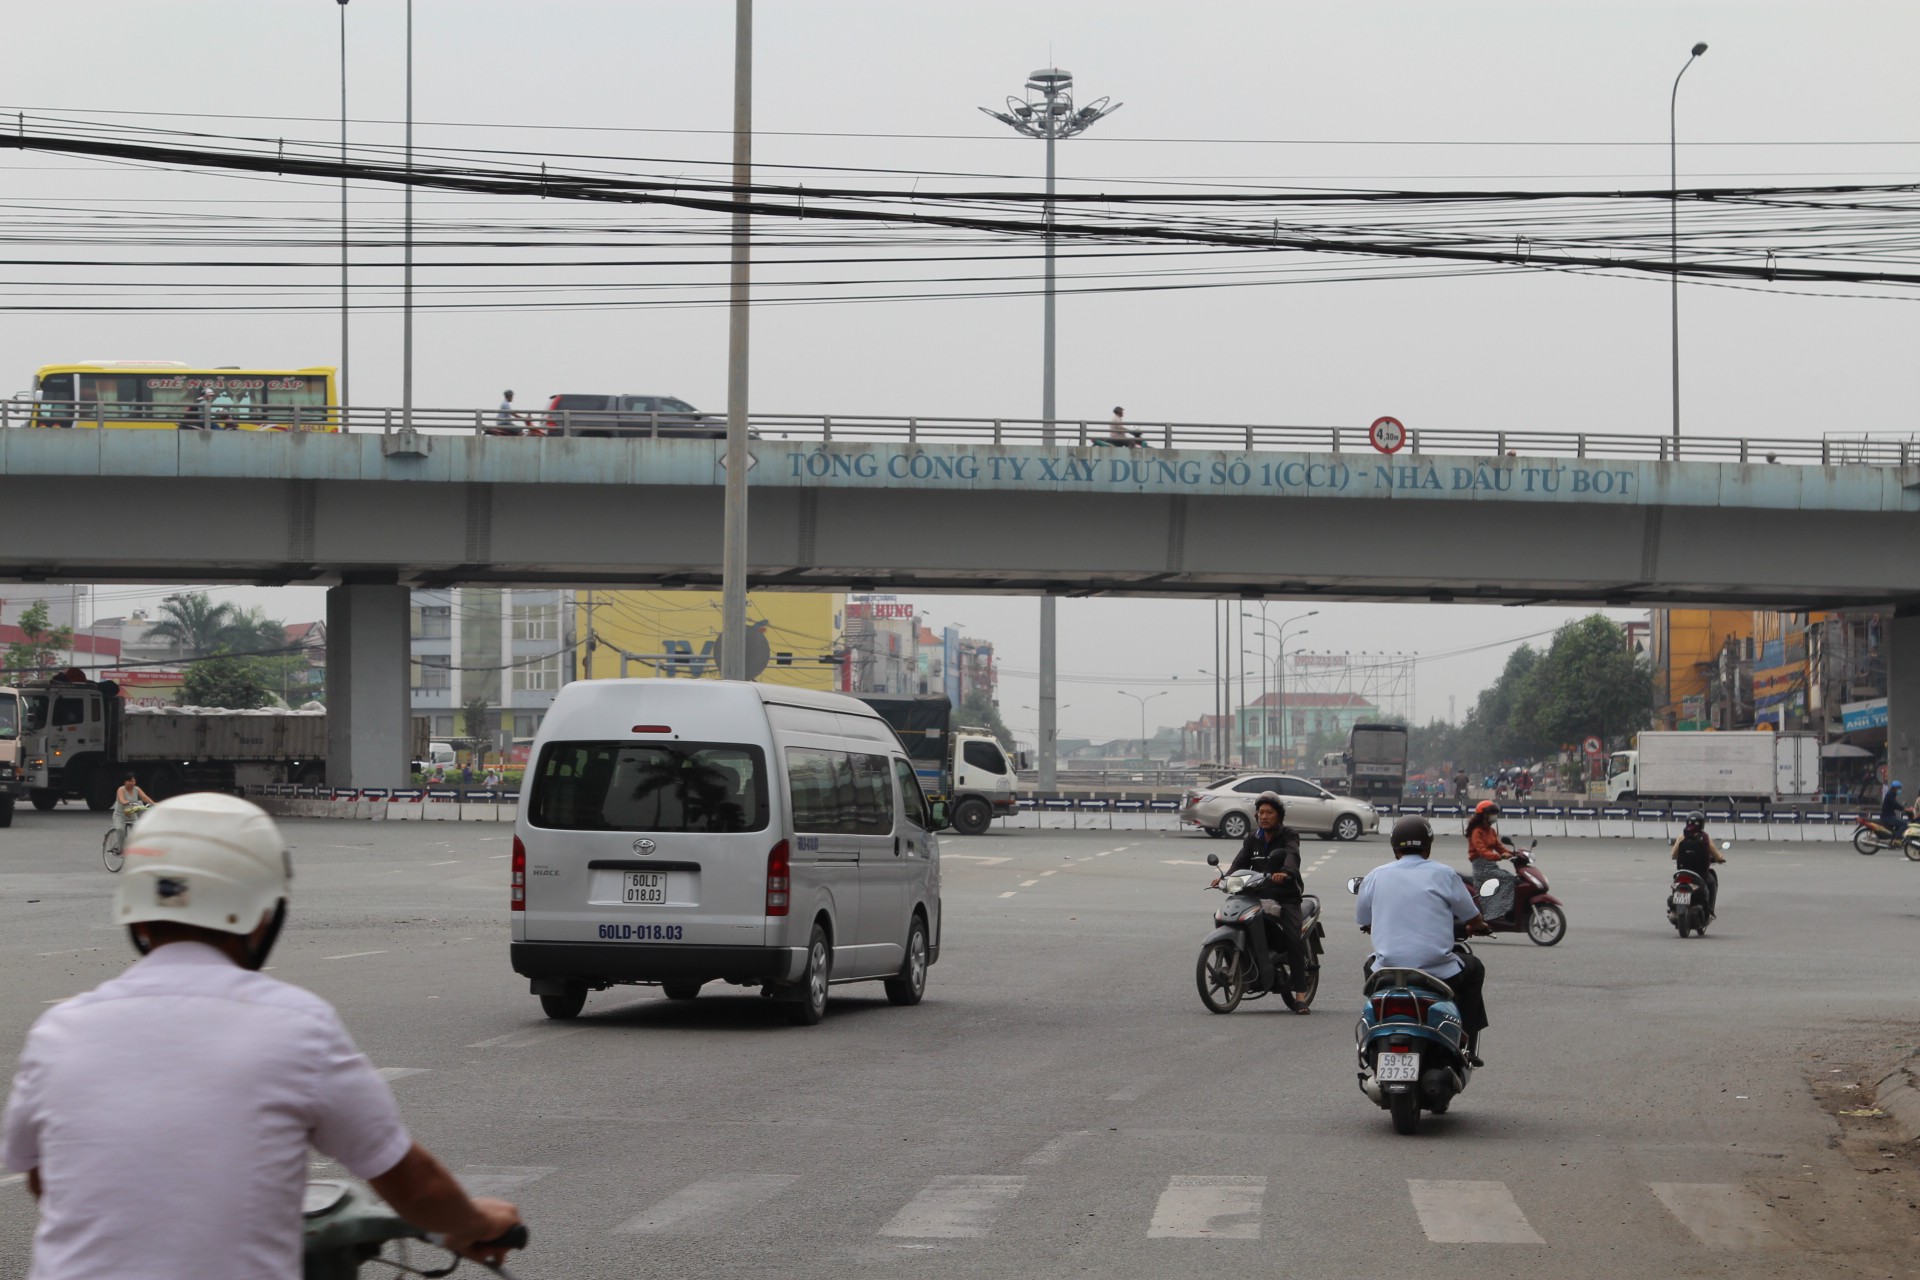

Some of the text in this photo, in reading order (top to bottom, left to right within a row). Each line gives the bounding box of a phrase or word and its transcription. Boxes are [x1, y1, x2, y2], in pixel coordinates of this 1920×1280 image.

[228, 379, 264, 389] CAO
[787, 444, 878, 478] TỔNG
[887, 450, 979, 480] CÔNG
[987, 457, 1029, 481] TY
[1038, 453, 1102, 482] XÂY
[1210, 454, 1251, 486] SỐ
[1374, 460, 1444, 491] NHÀ
[1451, 459, 1512, 491] ĐẦU
[1520, 465, 1566, 493] TƯ
[1571, 470, 1634, 495] BOT
[533, 869, 560, 877] HIACE
[632, 873, 658, 887] 60LD
[627, 888, 662, 901] 018.03
[599, 924, 683, 940] 60LD-018.03
[1380, 1067, 1417, 1080] 237.52
